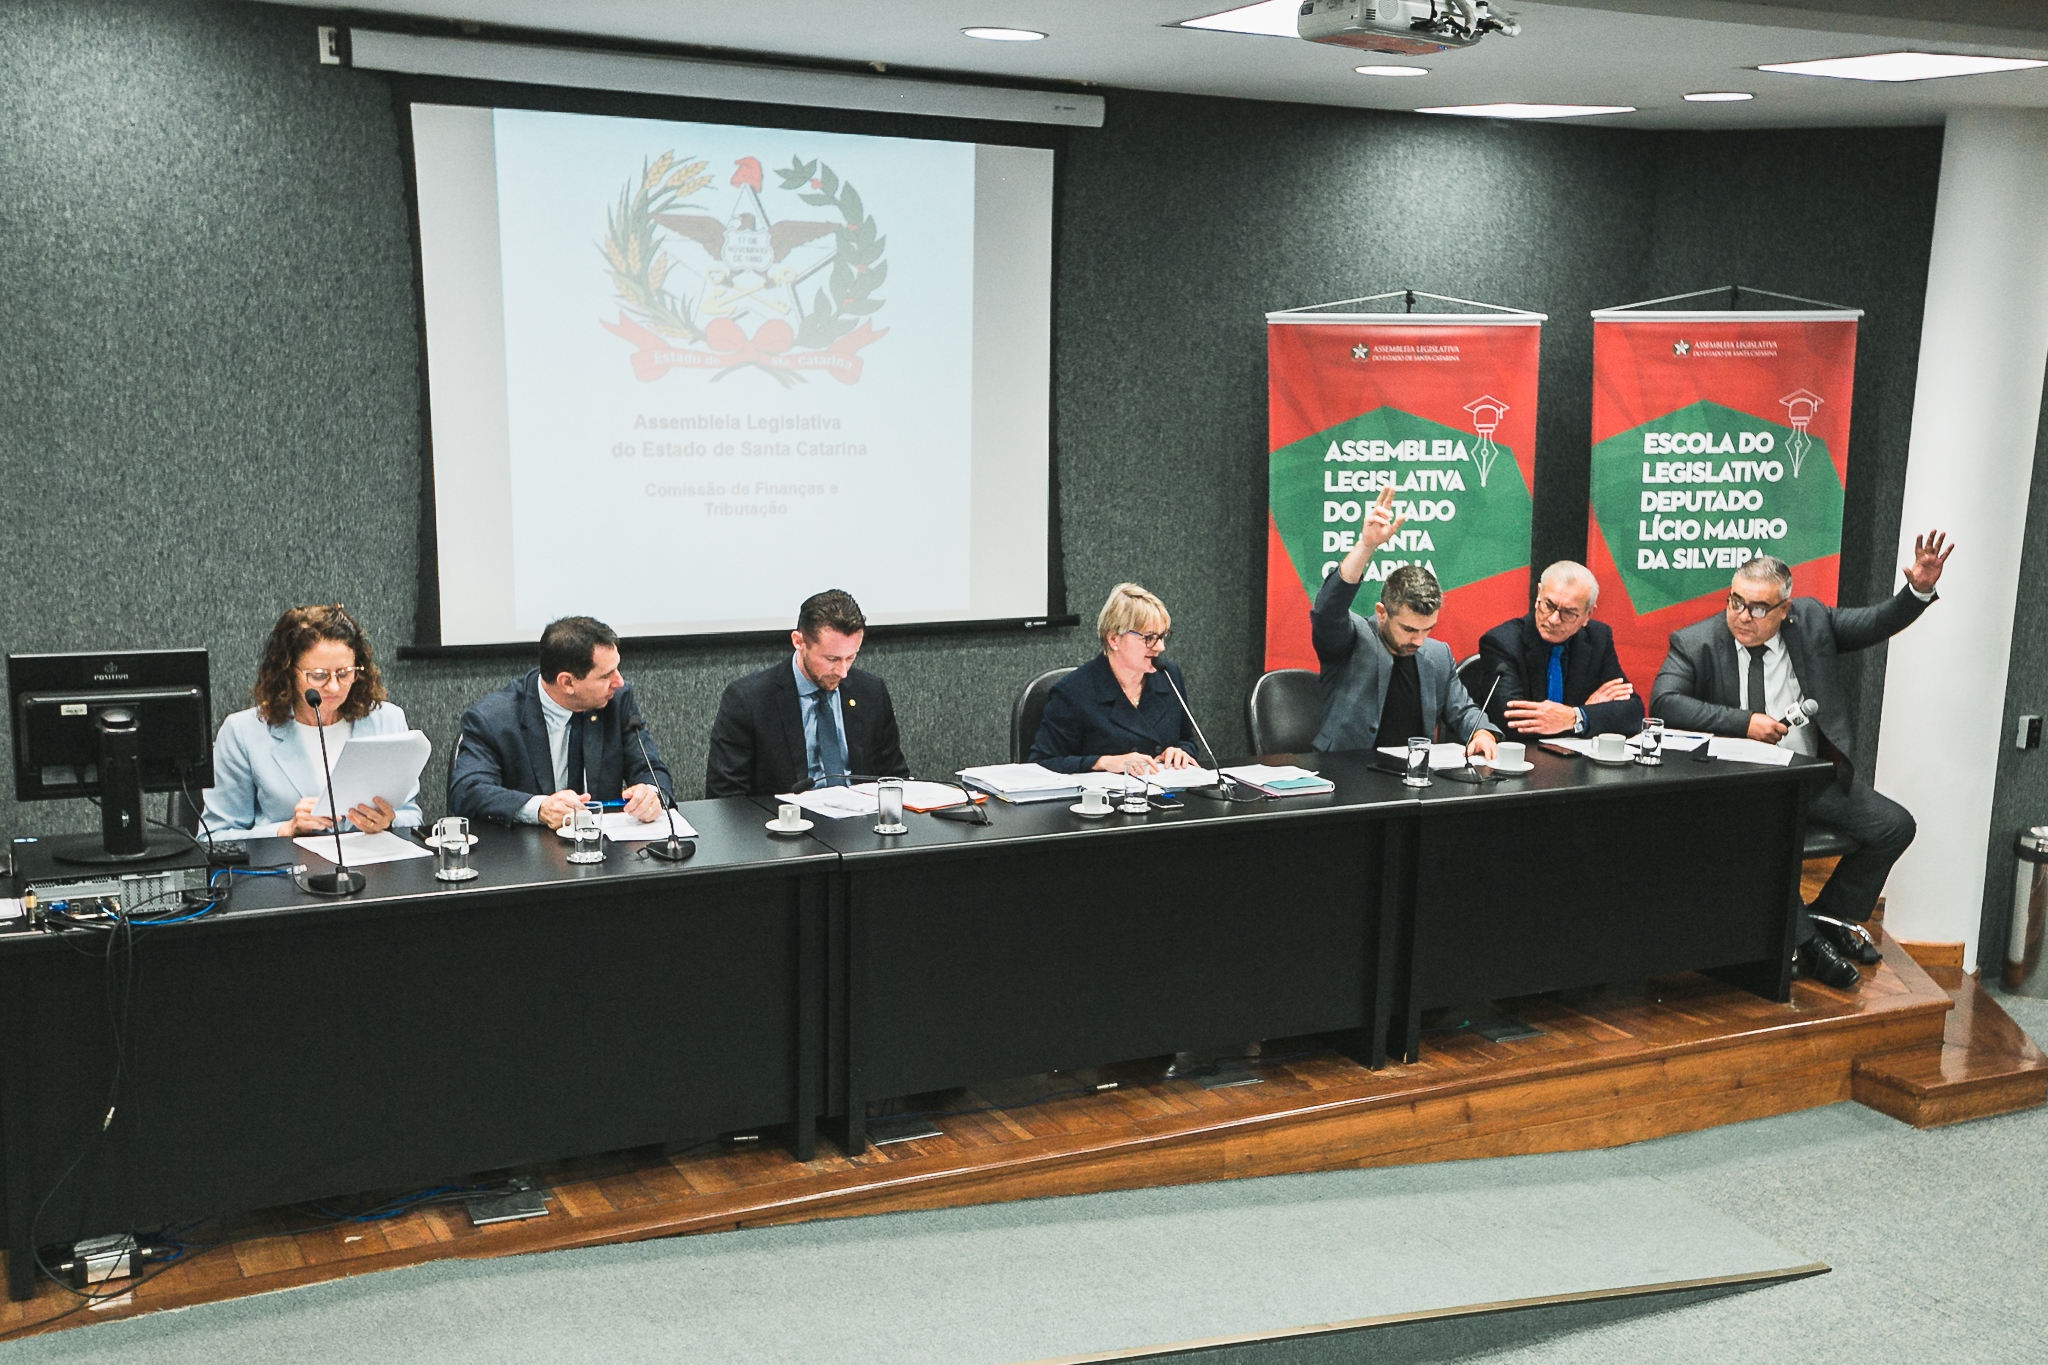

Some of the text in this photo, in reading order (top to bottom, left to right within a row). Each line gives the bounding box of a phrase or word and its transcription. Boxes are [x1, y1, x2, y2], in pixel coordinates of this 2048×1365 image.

[1373, 345, 1460, 353] ASSEMBLEIA LEGISLATIVA
[1694, 341, 1778, 349] ASSEMBLEIA LEGISLATIVA
[653, 351, 700, 364] Estado
[704, 354, 721, 365] de
[797, 355, 853, 369] Catarina
[634, 414, 841, 433] Assembleia Legislativa
[611, 440, 868, 457] do Estado de Santa Catarina
[1324, 439, 1470, 462] ASSEMBLEIA
[1644, 432, 1775, 454] ESCOLA DO
[1324, 469, 1466, 492] LEGISLATIVA
[1642, 460, 1784, 483] LEGISLATIVO
[645, 481, 838, 499] Comissão de Finanças e
[704, 501, 787, 518] Tributação
[1323, 499, 1456, 522] DO ETADO
[1641, 490, 1763, 512] DEPUTADO
[1639, 514, 1788, 541] LÍCIO MAURO
[1323, 530, 1435, 552] DE ANTA
[1637, 548, 1670, 569] DA
